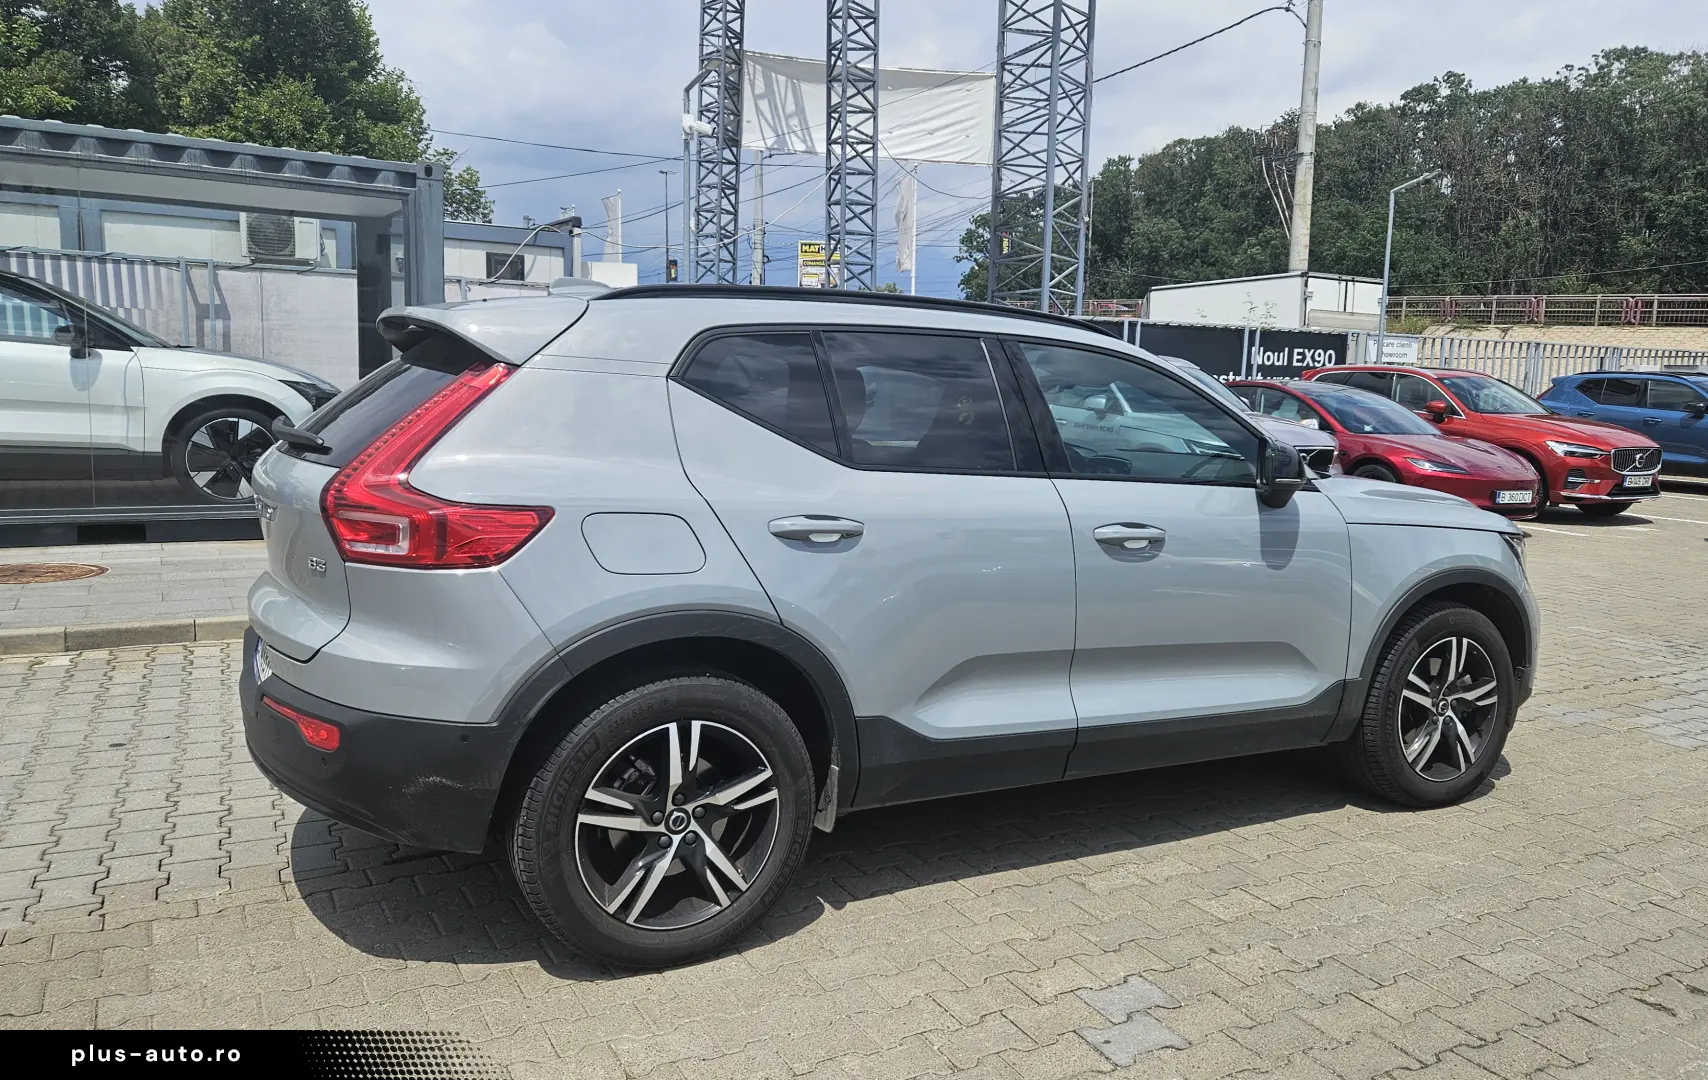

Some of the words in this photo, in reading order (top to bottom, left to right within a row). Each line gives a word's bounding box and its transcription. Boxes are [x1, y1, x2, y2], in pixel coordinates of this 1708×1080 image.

[1251, 347, 1288, 366] Noul
[1293, 348, 1336, 367] EX90
[1381, 351, 1408, 359] howroom
[1500, 492, 1506, 501] B
